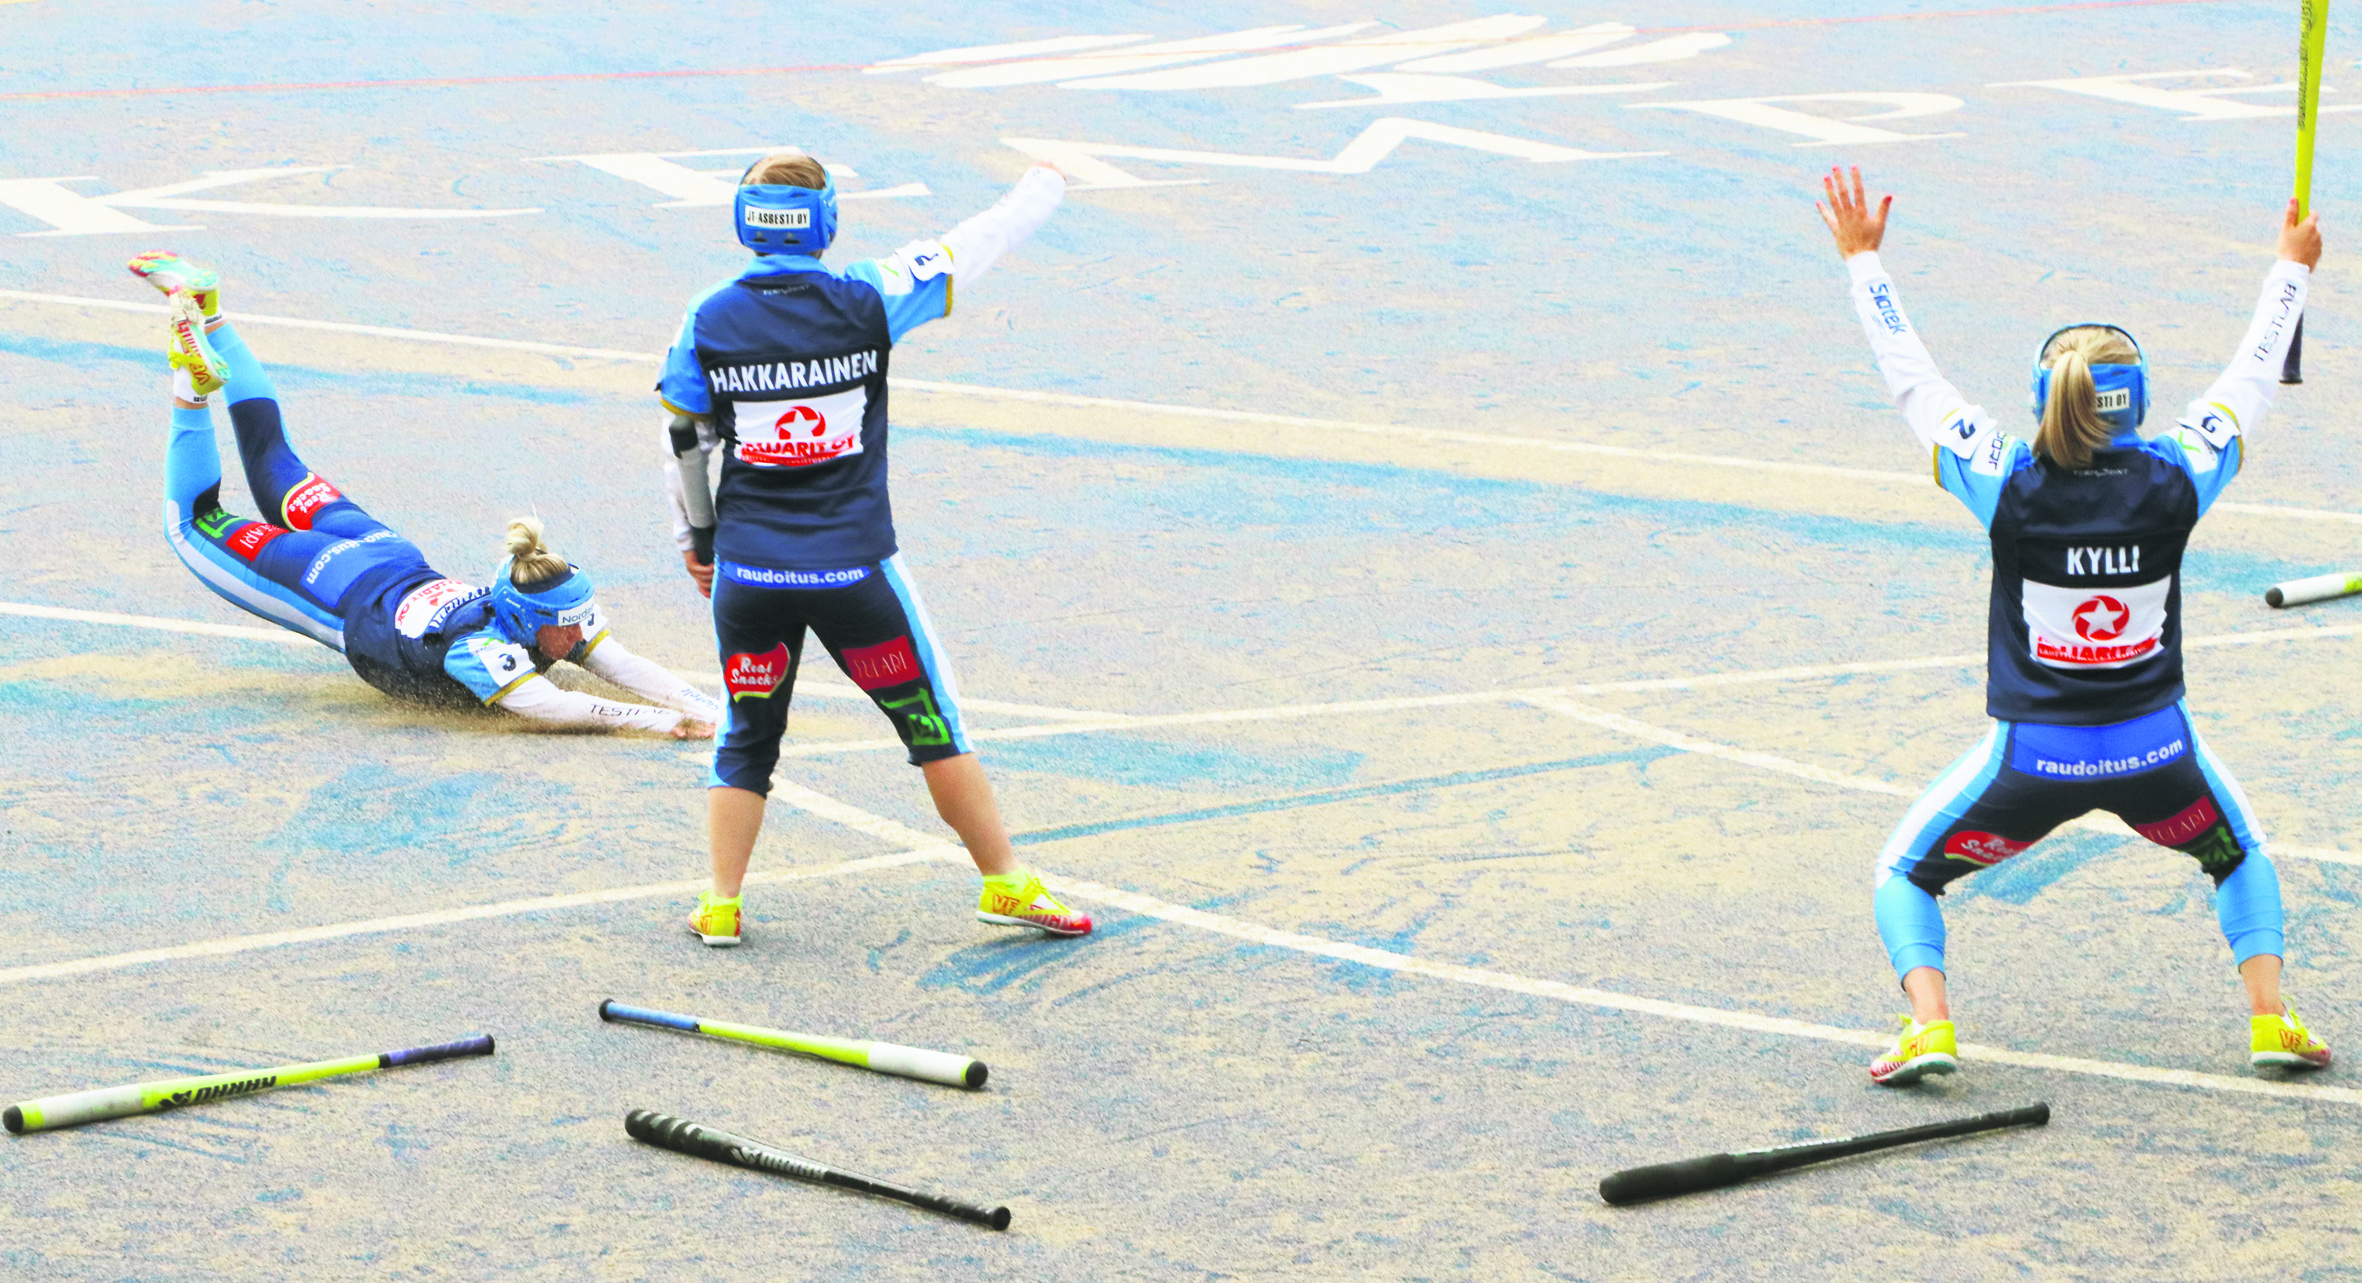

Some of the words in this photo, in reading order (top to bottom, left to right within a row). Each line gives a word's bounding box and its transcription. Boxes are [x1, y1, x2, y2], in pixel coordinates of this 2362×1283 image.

[709, 350, 878, 393] HAKKARAINEN
[289, 483, 331, 512] Snacks
[300, 491, 332, 514] Real
[2067, 545, 2140, 575] KYLLI
[736, 566, 865, 585] raudoitus.com
[499, 653, 516, 671] 3
[740, 656, 772, 673] Real
[731, 668, 778, 685] Snacks
[2036, 738, 2184, 776] raudoitus.com
